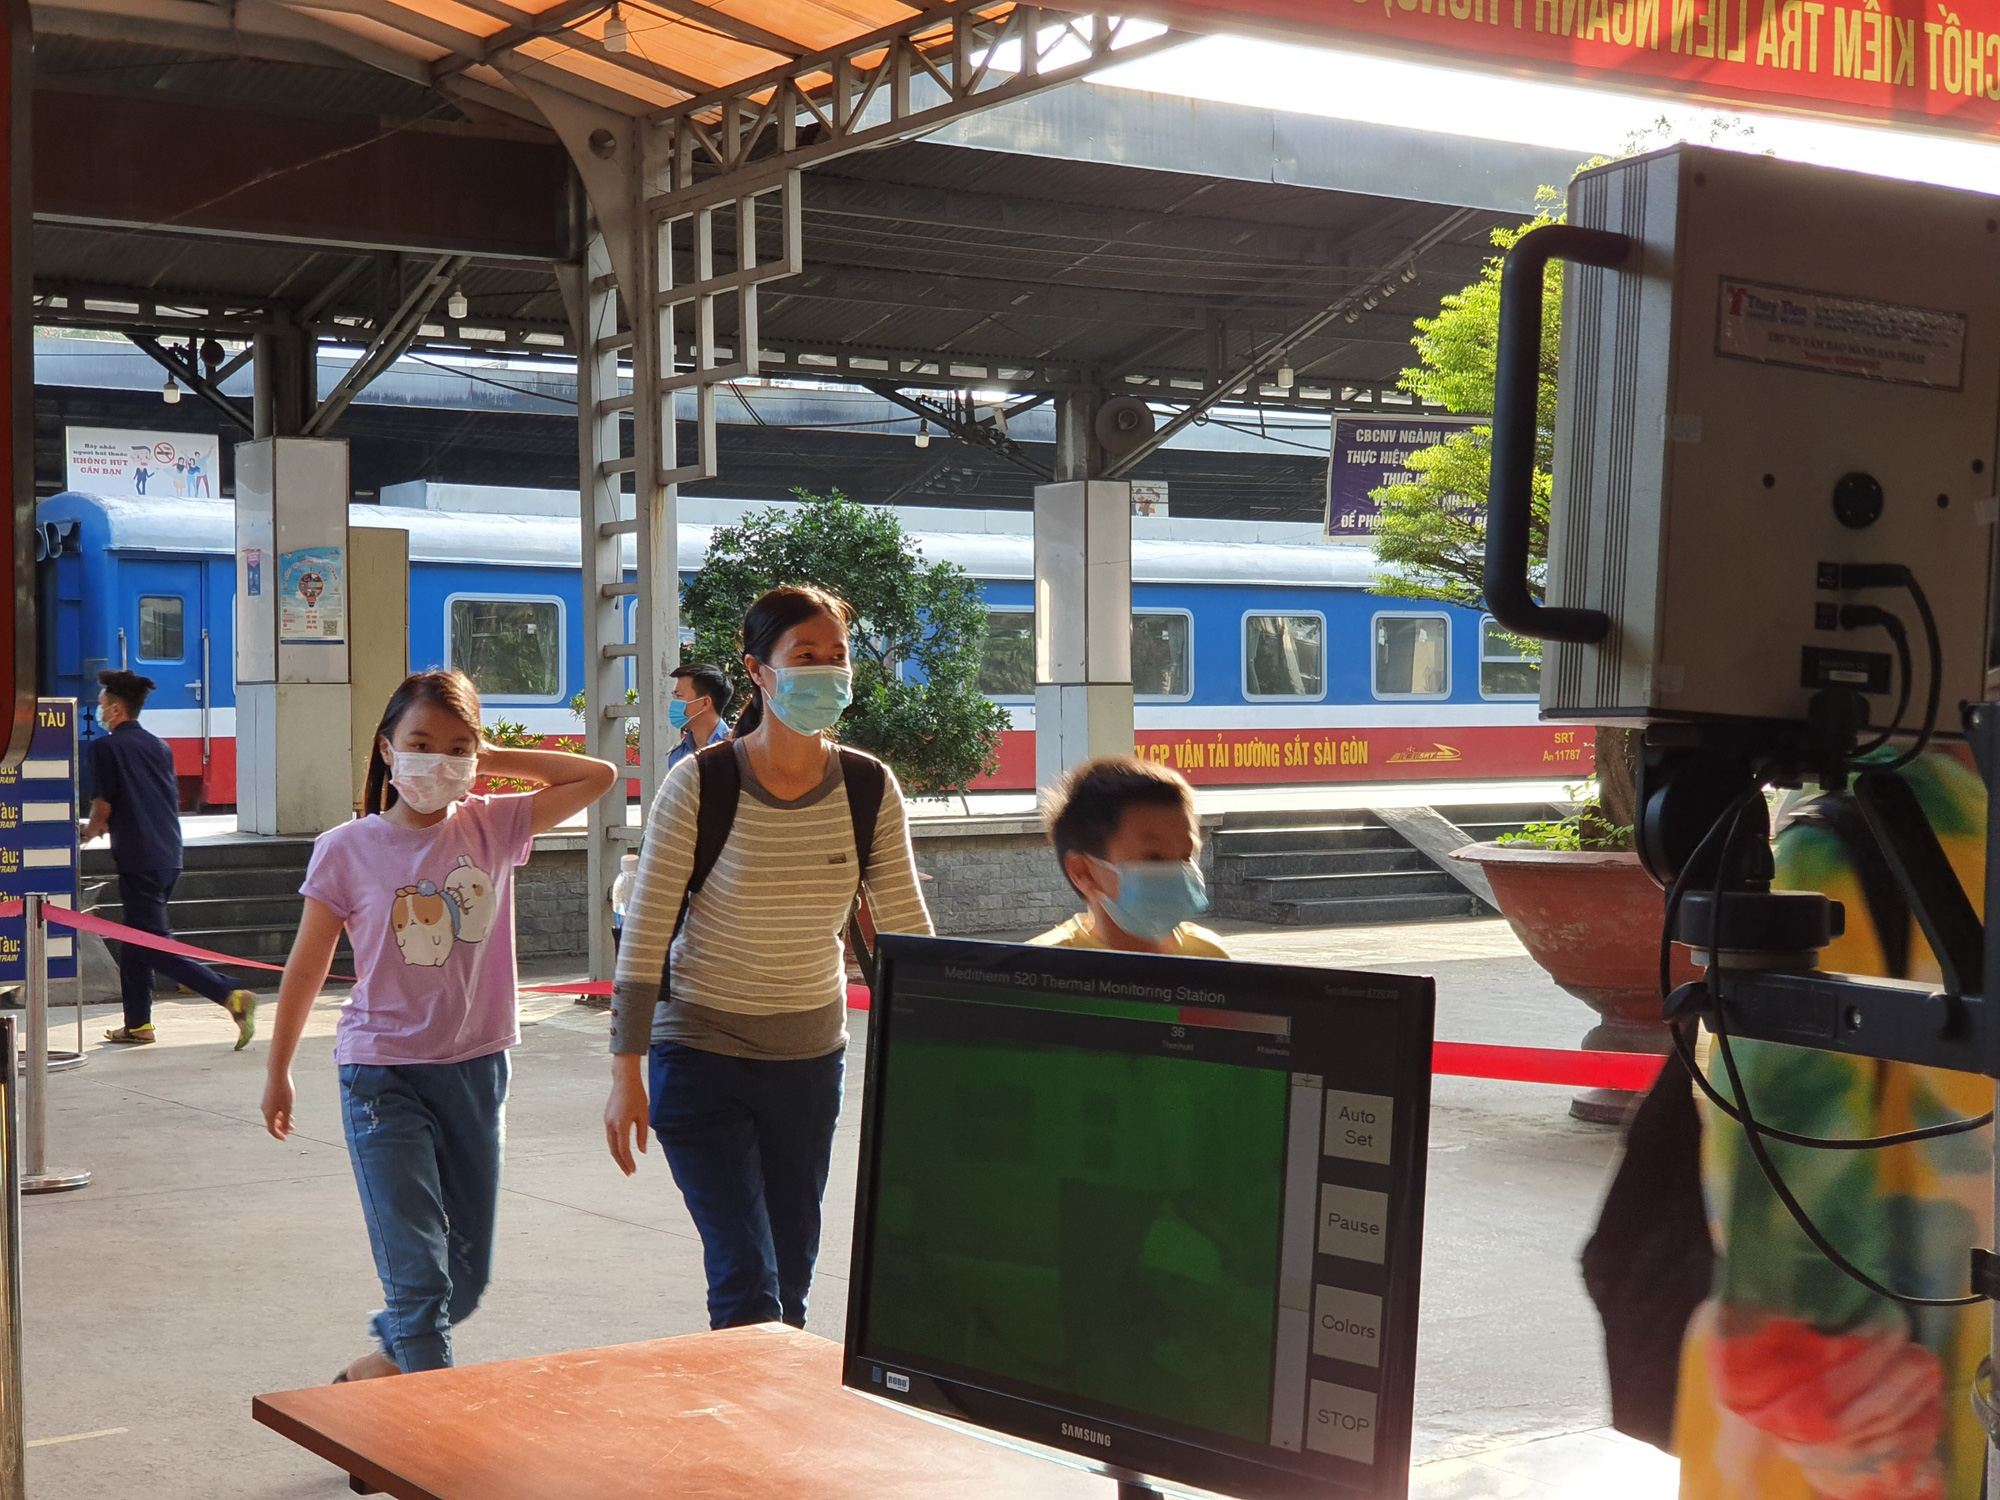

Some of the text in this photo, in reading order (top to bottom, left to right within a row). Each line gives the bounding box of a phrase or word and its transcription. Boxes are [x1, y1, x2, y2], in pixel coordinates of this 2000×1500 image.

[1355, 428, 1397, 443] CBCNV
[1398, 427, 1441, 444] NGÀNH
[73, 457, 107, 465] KHÔNG
[1346, 450, 1377, 466] THỰC
[1341, 510, 1357, 528] ĐỂ
[38, 708, 67, 727] TÀU
[1554, 732, 1575, 744] SRT
[1150, 743, 1170, 768] CP
[1175, 738, 1205, 774] VẬN
[1208, 733, 1230, 768] TẢI
[1233, 736, 1281, 768] ĐƯỜNG
[1284, 733, 1310, 766] SẮT
[1313, 737, 1338, 766] SÀI
[1340, 735, 1369, 765] GÒN
[1555, 750, 1581, 761] 11787
[945, 966, 1225, 1004] Meditherm 520 Thermal Monitoring Station
[1170, 1026, 1185, 1038] 36
[1338, 1105, 1376, 1124] Auto
[1344, 1130, 1373, 1148] Set
[1328, 1212, 1380, 1236] Pause
[1321, 1314, 1376, 1339] Colors
[887, 1375, 907, 1387] ROBO
[1317, 1408, 1370, 1432] STOP
[1061, 1422, 1112, 1447] SAMSUNG
